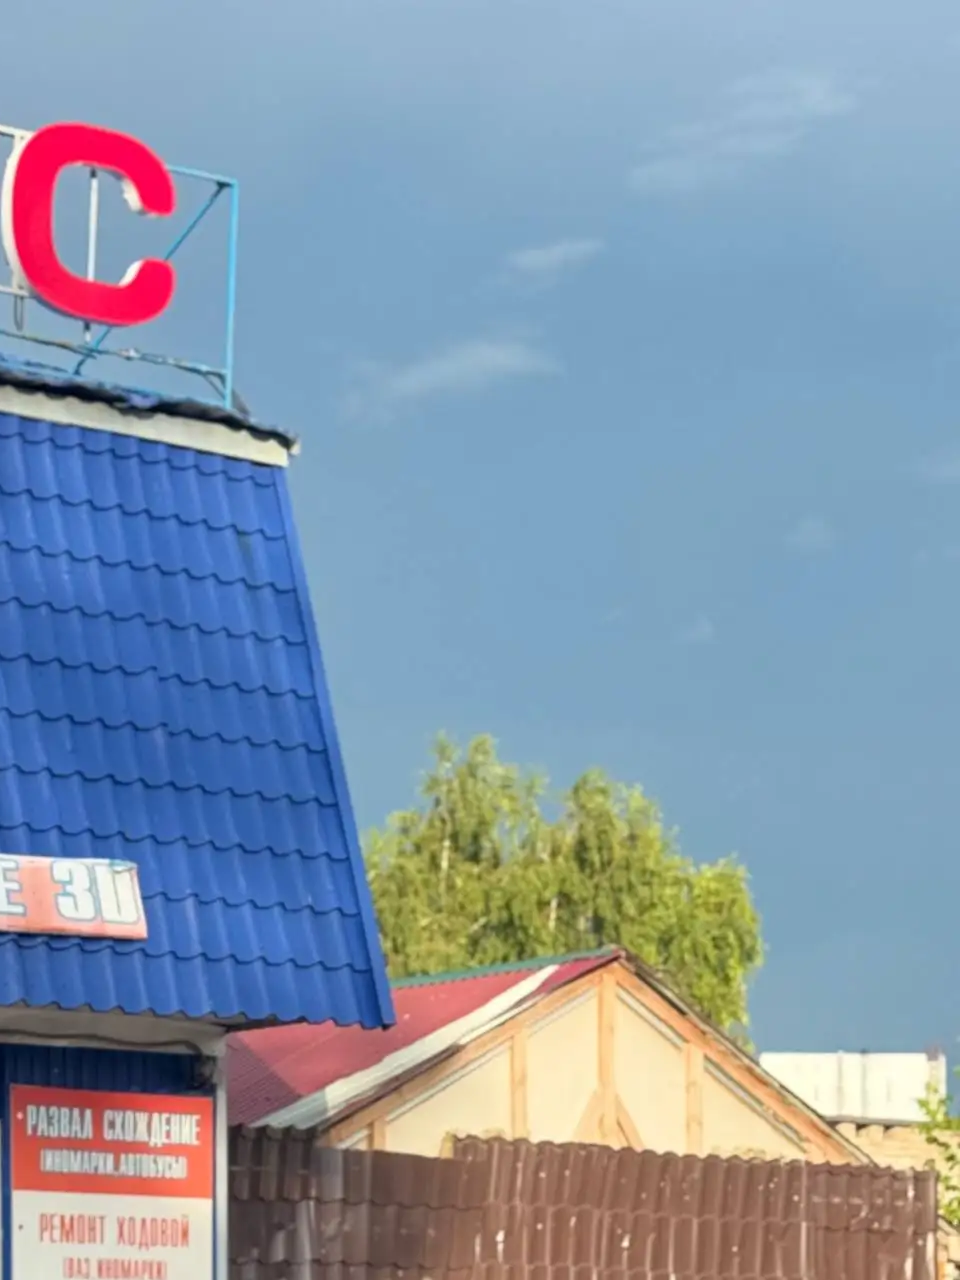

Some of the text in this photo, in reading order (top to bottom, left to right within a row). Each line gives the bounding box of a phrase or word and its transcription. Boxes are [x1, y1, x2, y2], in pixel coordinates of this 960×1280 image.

[26, 1104, 201, 1147] РАЗВАЛ СХОЖДЕНИЕ
[39, 1213, 190, 1250] РЕМОНТ ХОДОВОЙ
